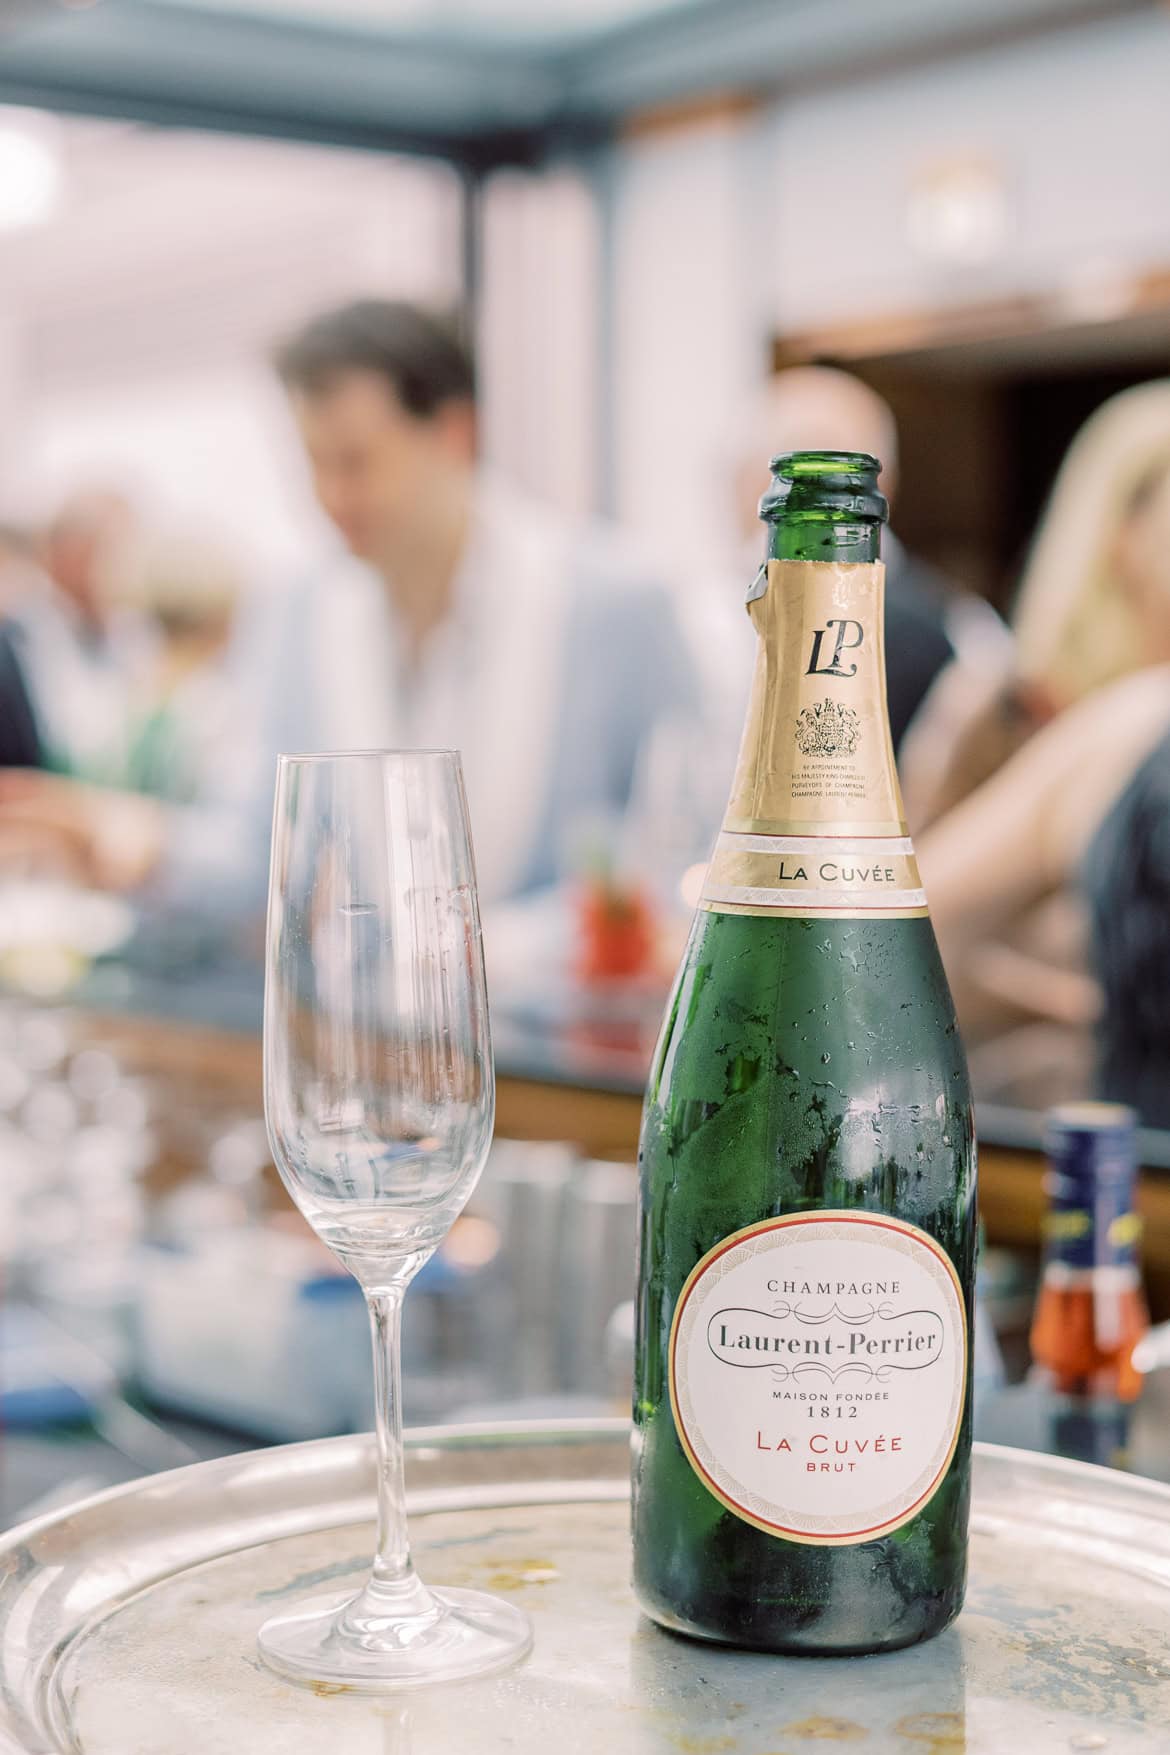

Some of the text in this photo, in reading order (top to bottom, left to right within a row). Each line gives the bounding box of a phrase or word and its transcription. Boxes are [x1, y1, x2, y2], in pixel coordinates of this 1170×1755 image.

[767, 1279, 901, 1295] CHAMPAGNE
[719, 1325, 936, 1355] Laurent-Perrier
[772, 1391, 889, 1401] MAISON FONDÉE
[807, 1406, 858, 1418] 1812
[806, 1462, 857, 1472] BRUT
